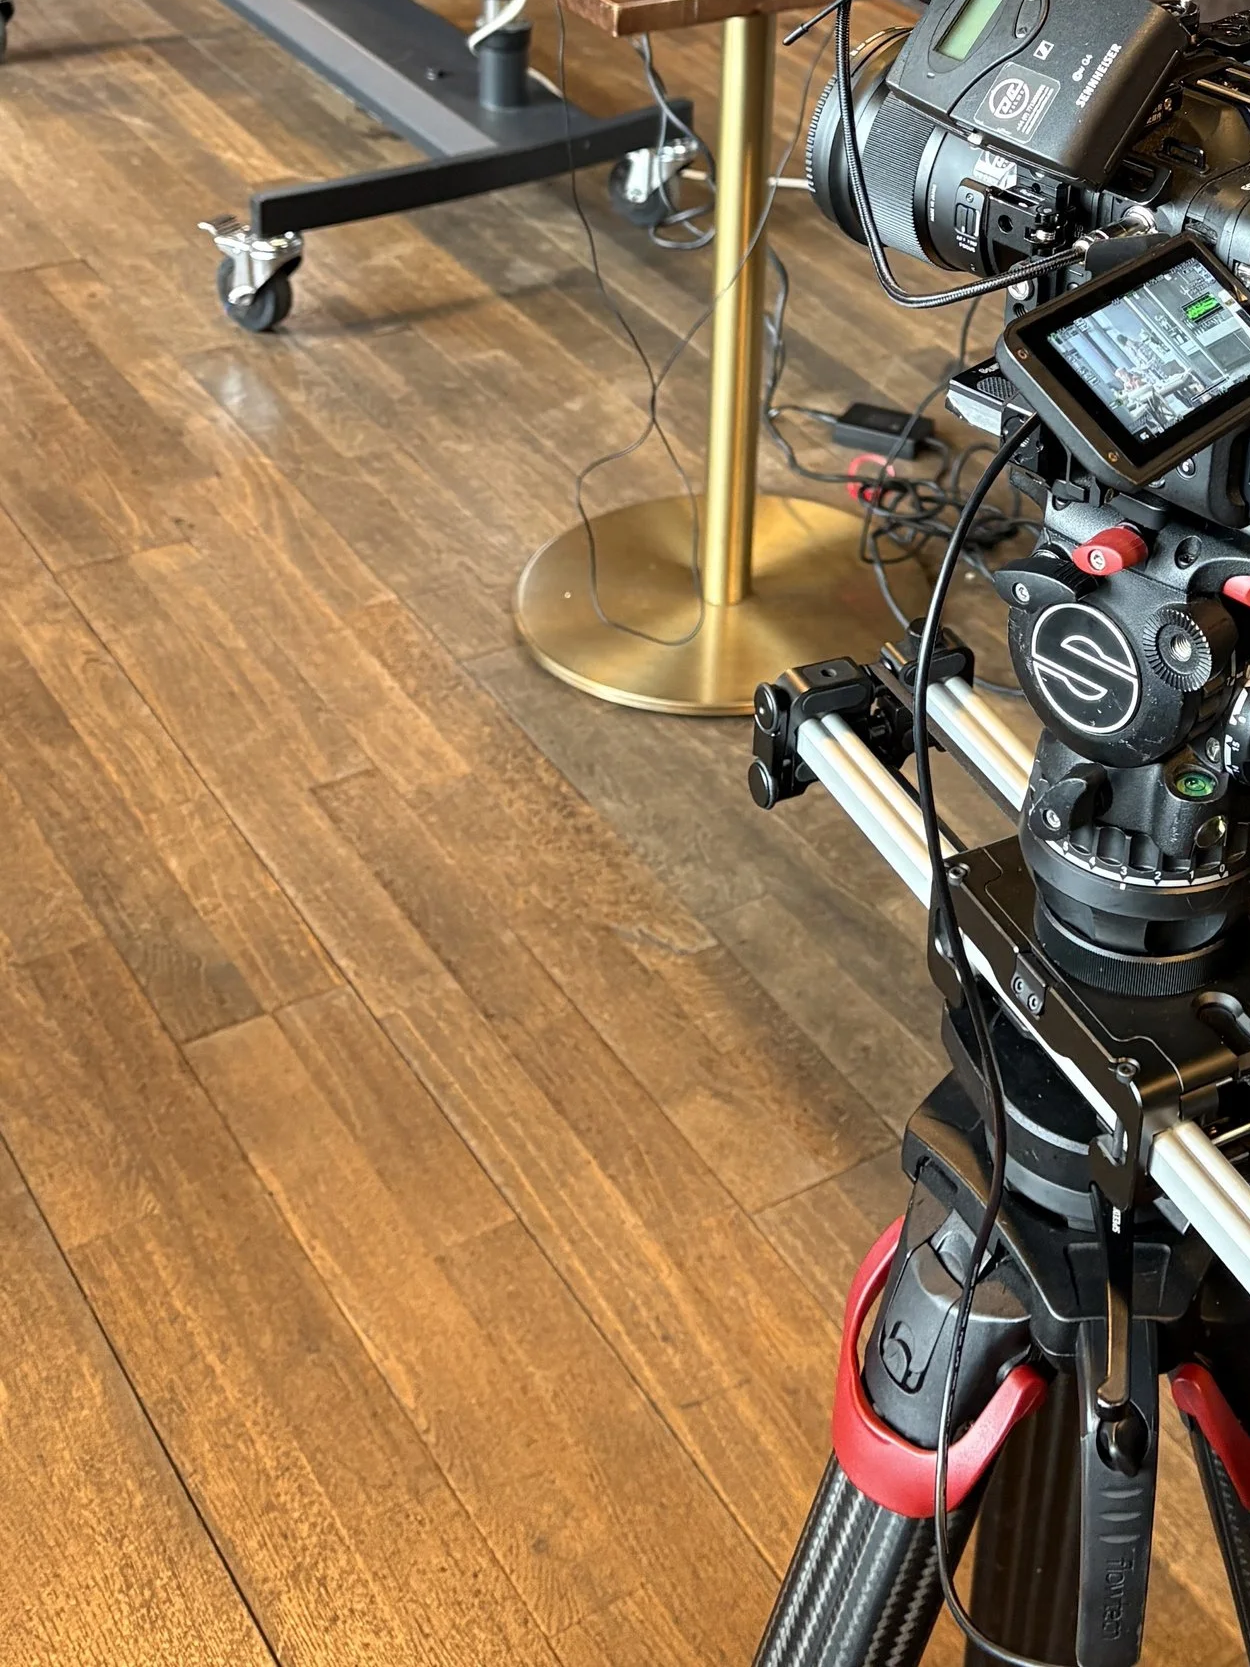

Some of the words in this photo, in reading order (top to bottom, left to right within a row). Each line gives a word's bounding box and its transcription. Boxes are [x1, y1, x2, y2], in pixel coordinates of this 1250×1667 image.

[1075, 43, 1122, 108] SENNHEISER
[1120, 865, 1128, 875] 3
[1154, 870, 1162, 880] 2
